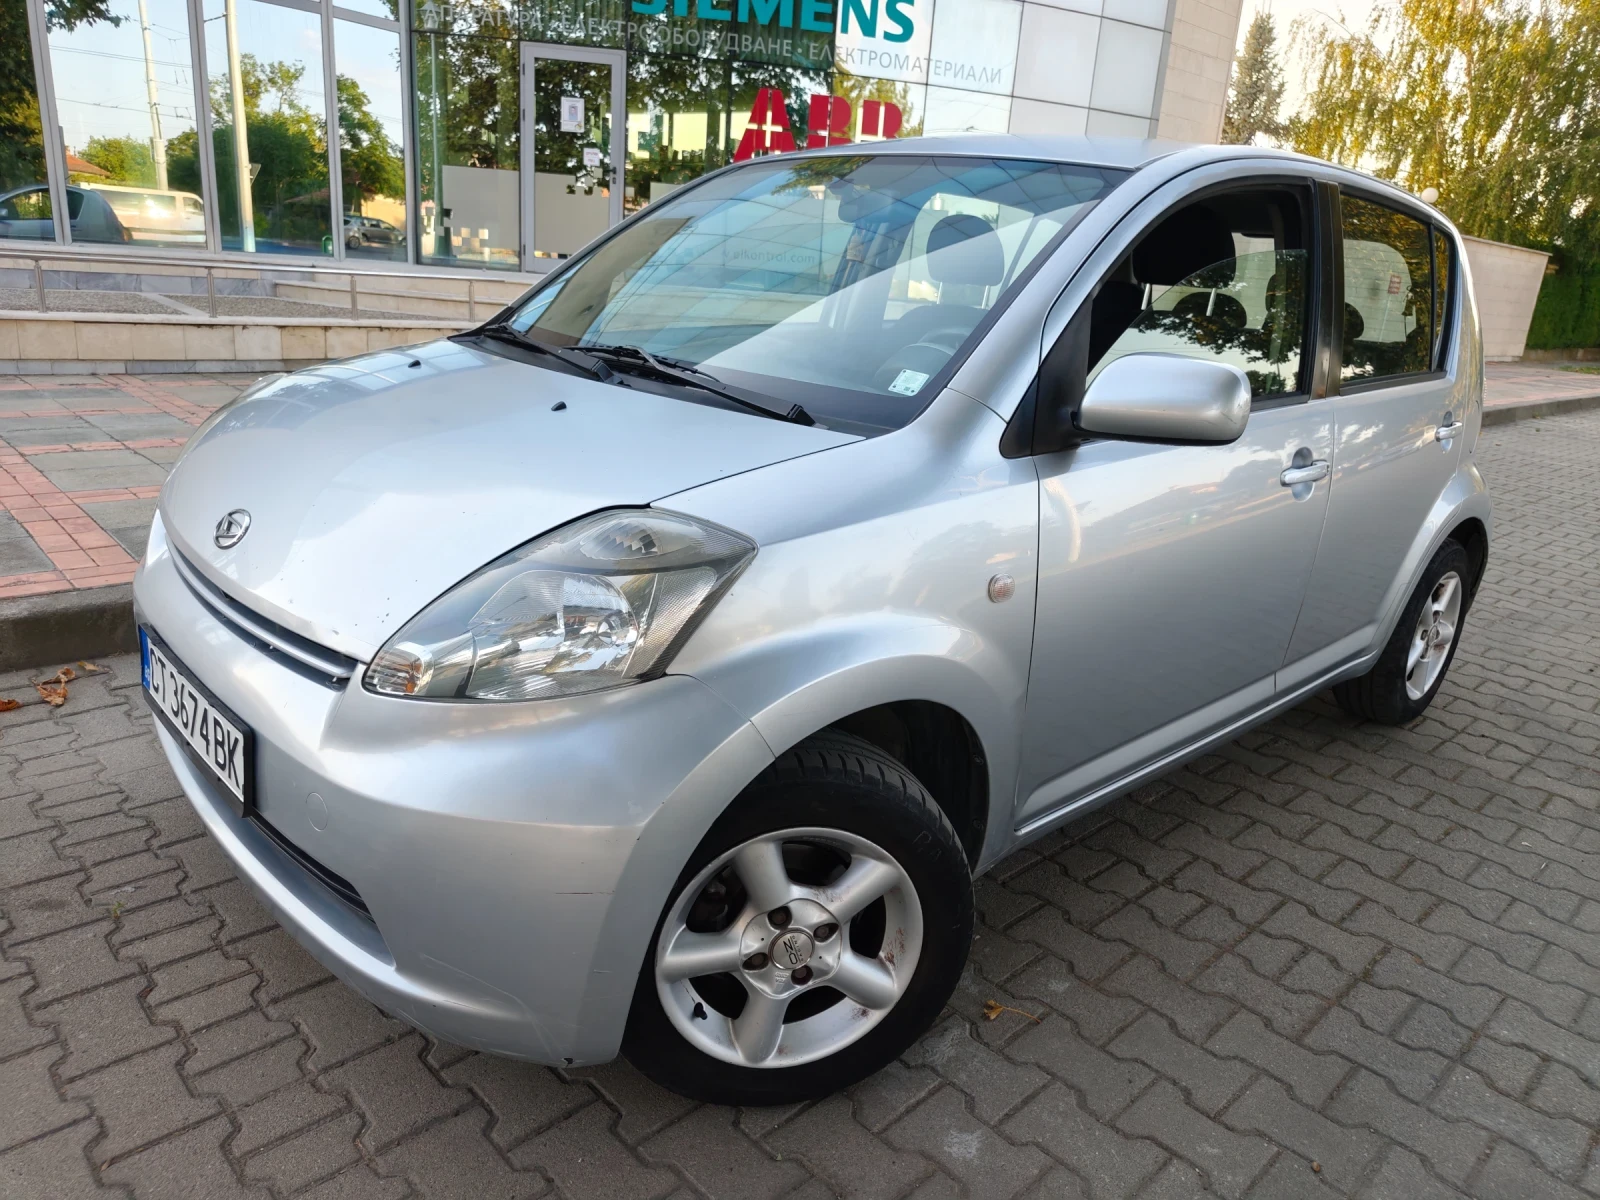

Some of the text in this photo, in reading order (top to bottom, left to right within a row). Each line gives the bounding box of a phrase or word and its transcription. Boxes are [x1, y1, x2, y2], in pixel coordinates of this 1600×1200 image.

[423, 4, 1002, 84] АПАРАТУРА ЕЛЕКТРООБОРУДВАНЕ ЕЛЕКТРОМАТЕРИАЛИ
[631, 0, 915, 43] MENS
